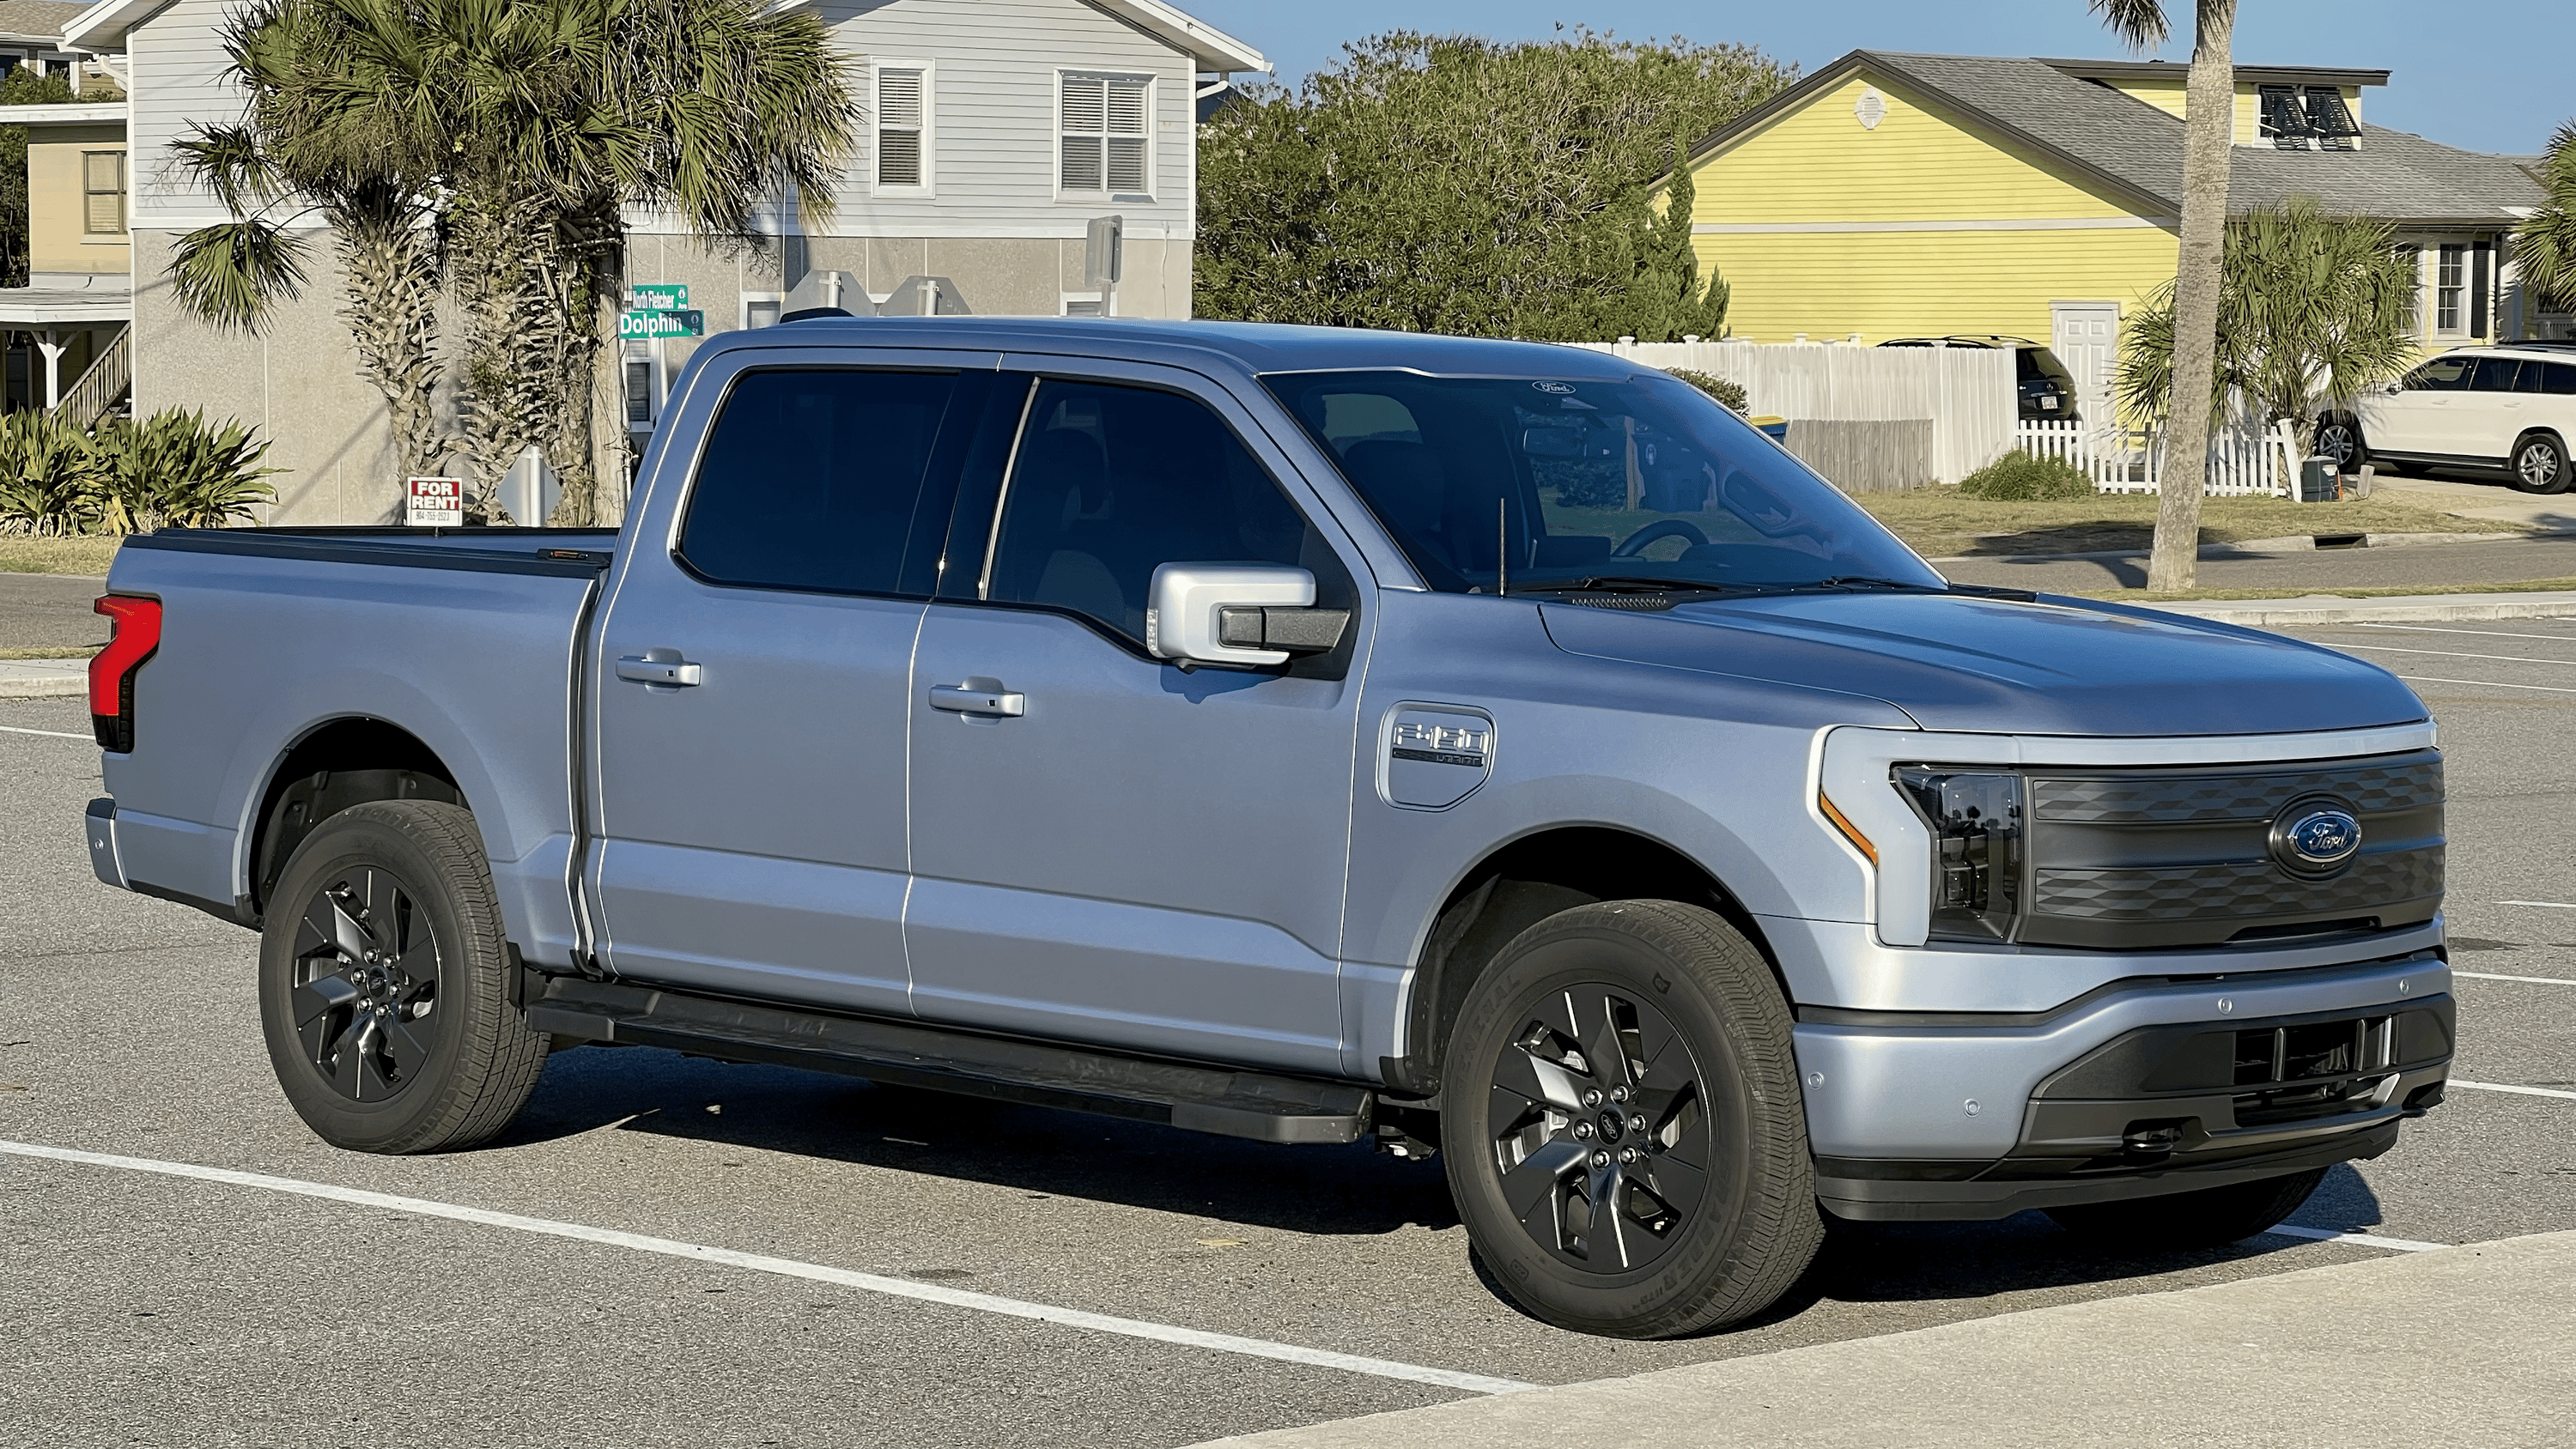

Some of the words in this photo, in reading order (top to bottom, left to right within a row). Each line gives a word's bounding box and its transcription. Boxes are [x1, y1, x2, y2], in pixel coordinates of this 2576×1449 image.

[632, 290, 647, 309] North
[648, 289, 675, 309] Fletcher
[620, 312, 683, 337] Dolphin
[1540, 382, 1570, 392] Ford
[417, 482, 453, 495] FOR
[412, 495, 459, 509] RENT
[2308, 822, 2349, 851] Ford
